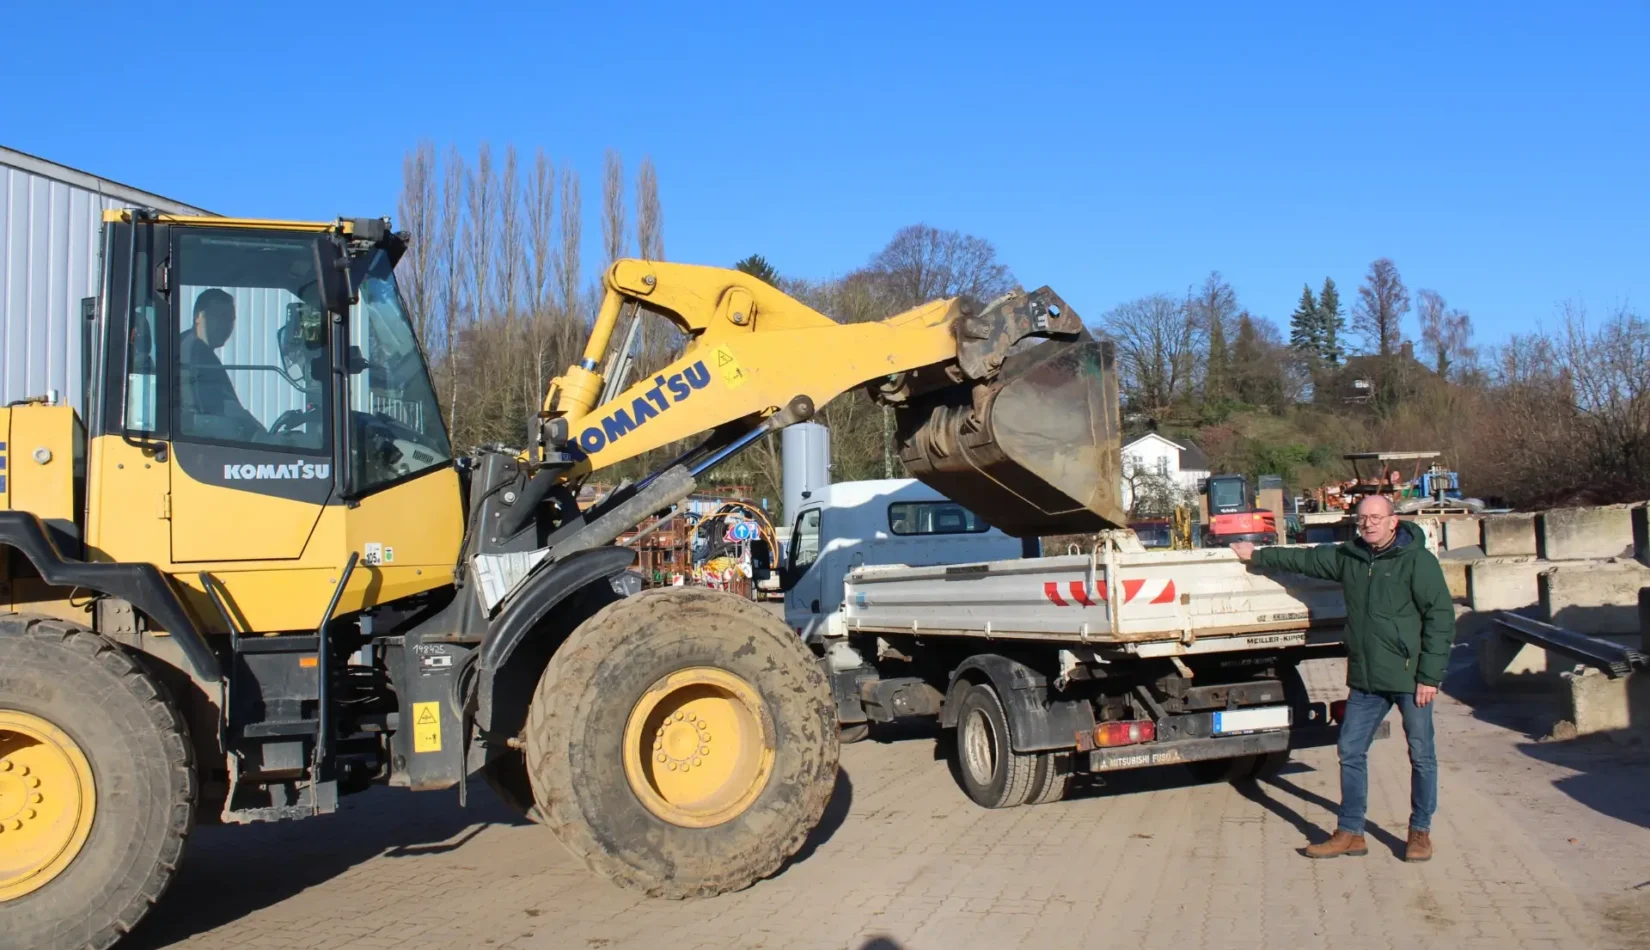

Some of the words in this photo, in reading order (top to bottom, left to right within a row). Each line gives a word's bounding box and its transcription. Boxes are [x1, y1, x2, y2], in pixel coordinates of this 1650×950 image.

[223, 459, 330, 480] KOMATSU
[1246, 633, 1308, 645] MEILLER-KIPPE
[1110, 754, 1150, 767] MITSUBISHI
[1152, 752, 1171, 763] FUSO
